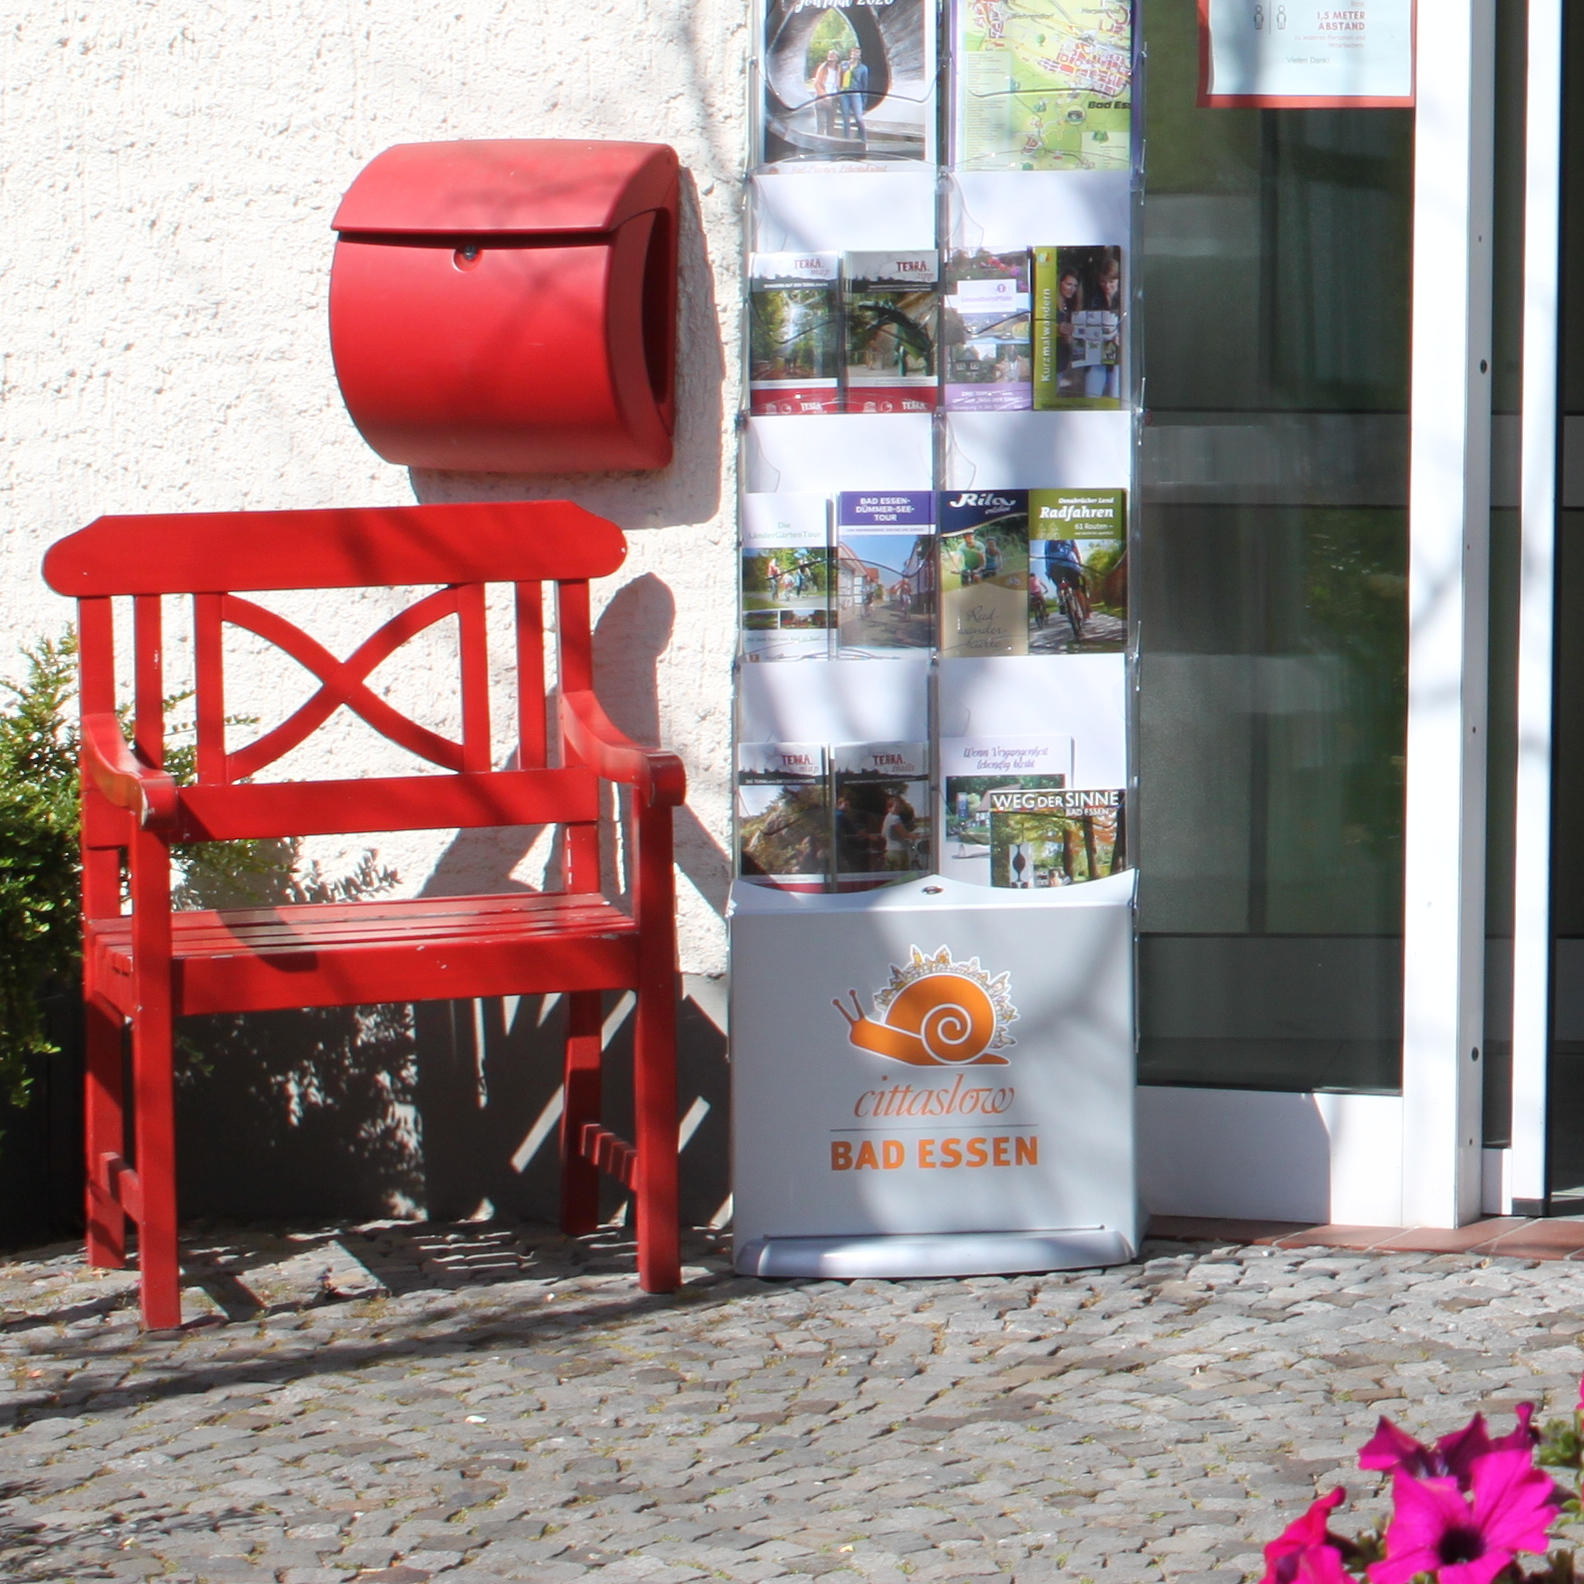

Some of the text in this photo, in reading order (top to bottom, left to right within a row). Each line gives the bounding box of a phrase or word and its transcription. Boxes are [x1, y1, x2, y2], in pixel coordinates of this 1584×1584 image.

[1333, 11, 1365, 20] METER
[1318, 22, 1365, 30] ABSTAND
[1041, 288, 1050, 382] Kurzmalwandern
[950, 493, 1017, 507] Rila
[874, 514, 897, 522] TOUR
[1039, 506, 1114, 522] Radfahren
[992, 791, 1119, 808] WEG DER SINNE
[854, 1073, 1016, 1117] cittaslow
[831, 1136, 1038, 1171] BAD ESSEN
